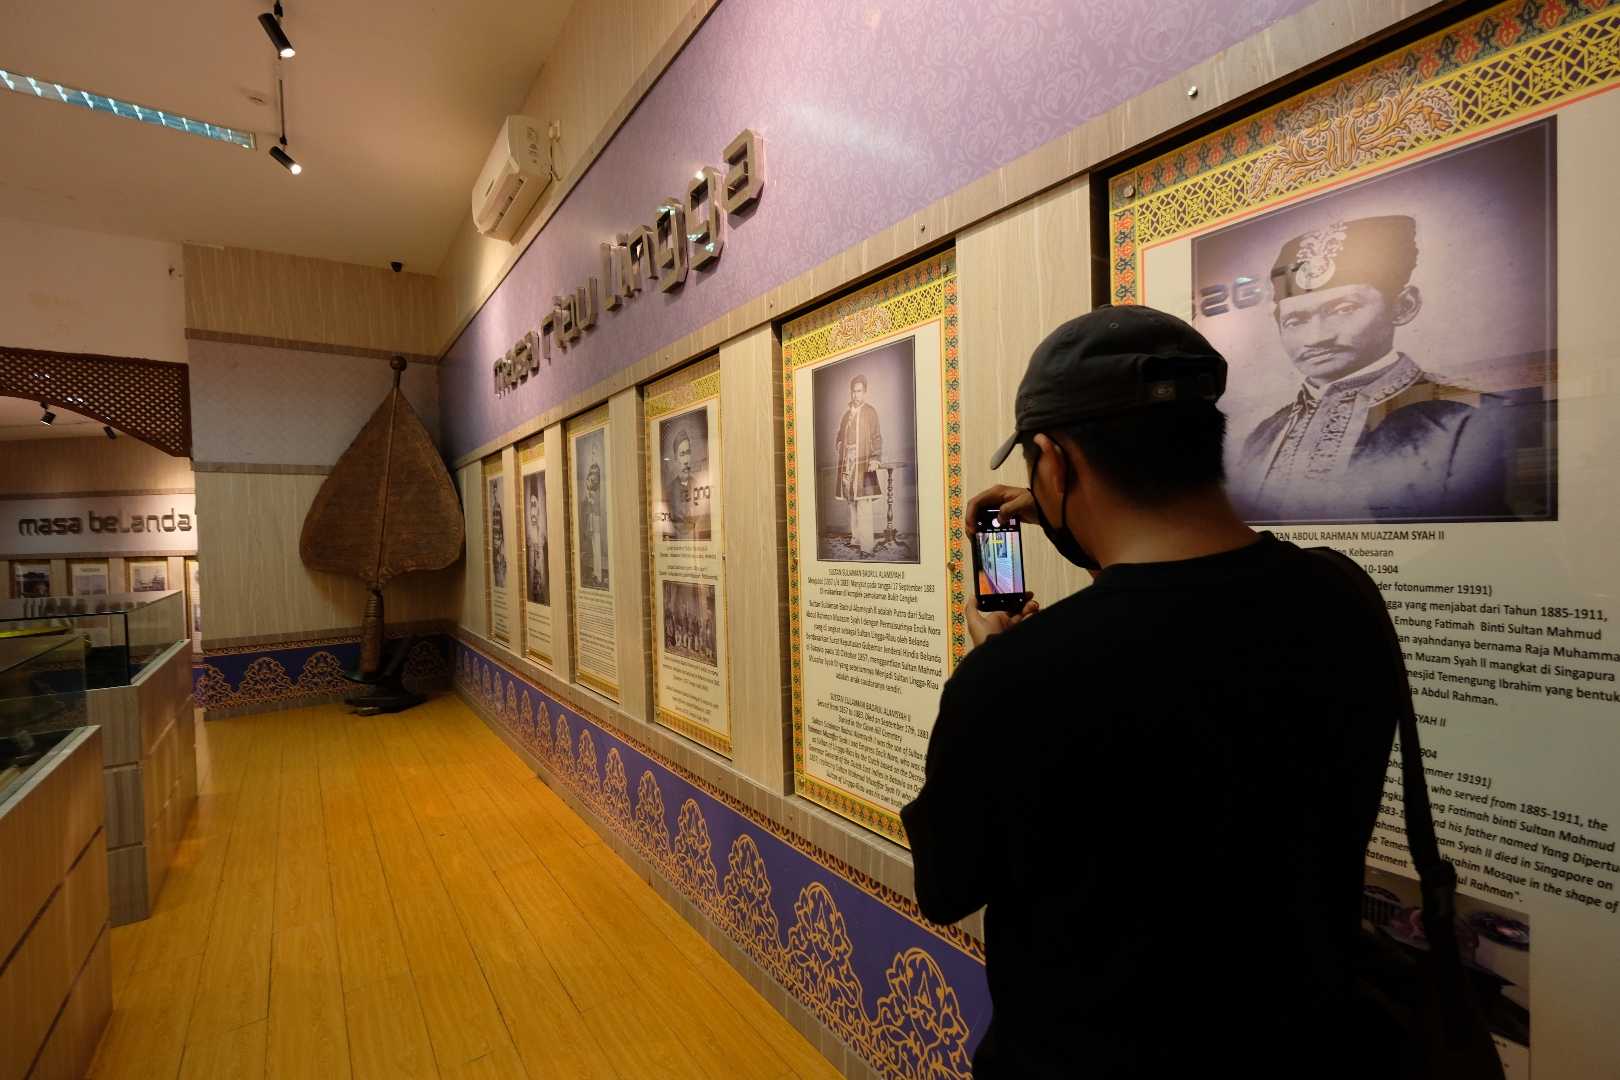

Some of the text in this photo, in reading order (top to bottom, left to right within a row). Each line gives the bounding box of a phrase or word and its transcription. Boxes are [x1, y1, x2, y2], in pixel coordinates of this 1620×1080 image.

[18, 516, 83, 536] masa
[1292, 531, 1318, 540] ABDUL
[1320, 531, 1358, 540] RAHMAN
[1361, 531, 1408, 541] MUAZZAM
[1411, 531, 1436, 541] SYAH
[1350, 548, 1394, 558] Kebesaran
[1363, 564, 1399, 574] 10-1904
[1394, 582, 1455, 594] fotonummer
[1457, 584, 1493, 598] 19191)
[918, 612, 935, 621] Sultan
[1405, 602, 1427, 612] yang
[1429, 602, 1477, 614] menjabat
[1480, 604, 1500, 614] dari
[1503, 604, 1537, 616] Tahun
[1541, 606, 1608, 622] 1885-1911,
[1394, 616, 1602, 640] Embung Fatimah Binti Sultan Mahmud
[908, 636, 930, 648] Belanda
[1413, 634, 1471, 650] ayahndanya
[1474, 640, 1522, 653] bernama
[1525, 644, 1550, 658] Raja
[1553, 646, 1620, 662] Muhamma
[920, 651, 942, 663] Belanda
[1415, 652, 1450, 664] Muzam
[1454, 656, 1478, 668] Syah
[1490, 661, 1537, 674] mangkat
[1540, 664, 1551, 675] di
[1554, 665, 1616, 682] Singapura
[902, 660, 917, 672] Sultan
[918, 664, 942, 677] Mahmud
[1421, 687, 1450, 700] Abdul
[1438, 671, 1496, 690] Temengung
[1499, 678, 1542, 693] Ibrahim
[1545, 686, 1574, 700] yang
[1576, 687, 1620, 702] bentuk
[1457, 772, 1492, 790] 19191)
[1430, 784, 1452, 796] who
[1454, 790, 1488, 804] served
[1490, 796, 1517, 811] from
[1588, 818, 1608, 832] the
[1448, 804, 1490, 822] Fatimah
[1492, 815, 1517, 830] binti
[1520, 821, 1556, 838] Sultan
[1558, 830, 1616, 852] Mahmud
[1448, 821, 1462, 832] his
[1464, 824, 1498, 842] father
[1500, 834, 1538, 852] named
[1542, 844, 1570, 862] Yang
[1572, 852, 1620, 874] Dipertu
[1457, 840, 1482, 855] Syah
[1494, 852, 1518, 865] died
[1520, 856, 1532, 868] in
[1534, 861, 1594, 886] Singapore
[1596, 879, 1614, 890] on
[1483, 865, 1527, 886] Mosque
[1530, 878, 1540, 890] in
[1544, 882, 1562, 896] the
[1565, 888, 1602, 907] shape
[1604, 901, 1620, 914] of
